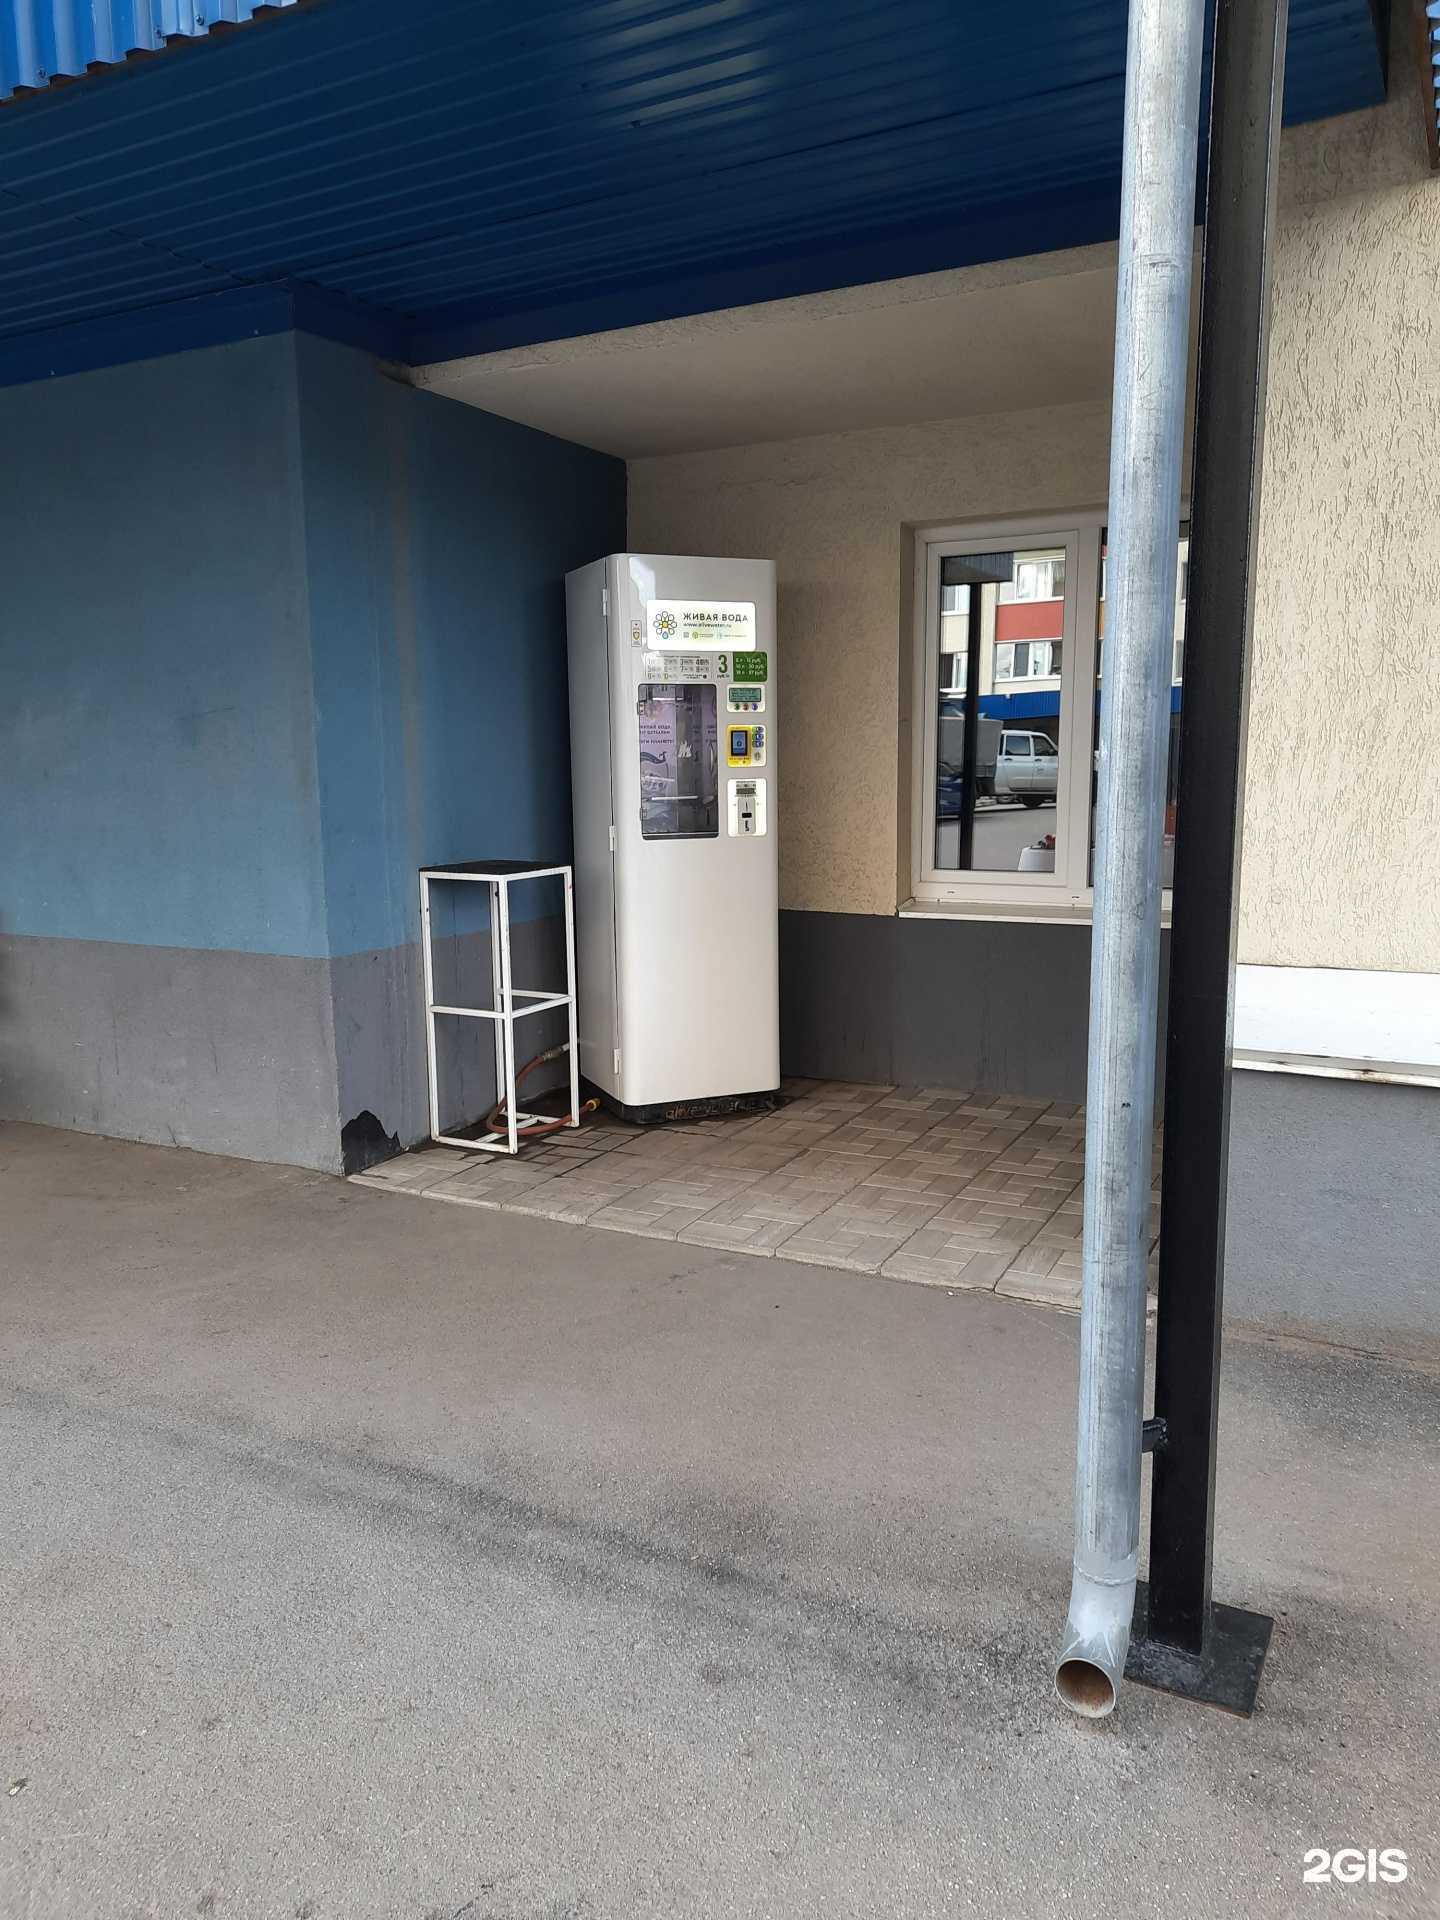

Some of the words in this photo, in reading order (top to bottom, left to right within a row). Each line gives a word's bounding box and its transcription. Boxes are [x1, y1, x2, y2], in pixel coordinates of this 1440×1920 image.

[683, 612, 719, 621] ЖИВАЯ
[721, 613, 748, 623] ВОДА
[718, 654, 728, 673] 3
